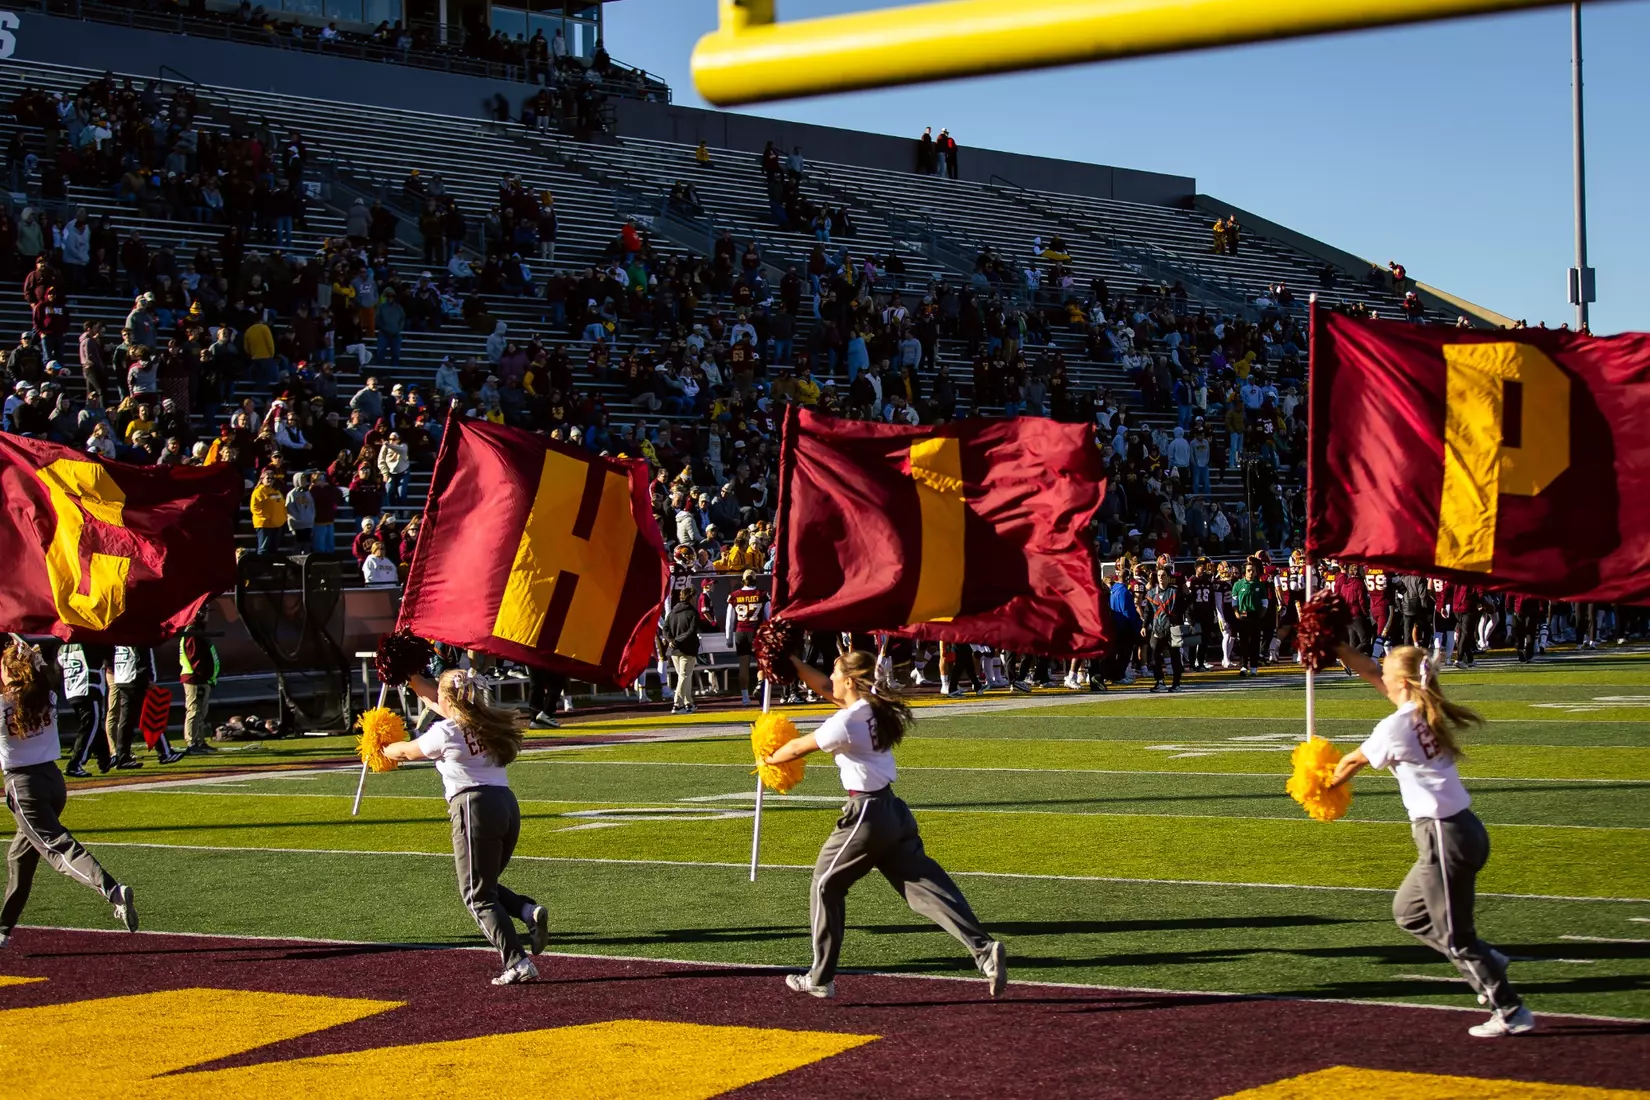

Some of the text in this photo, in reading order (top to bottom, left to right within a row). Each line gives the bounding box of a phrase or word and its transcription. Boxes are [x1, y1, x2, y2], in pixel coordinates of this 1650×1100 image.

[36, 459, 130, 630] C
[907, 438, 966, 625] I
[1435, 342, 1571, 573] P
[492, 449, 638, 666] H
[1365, 574, 1387, 592] 59
